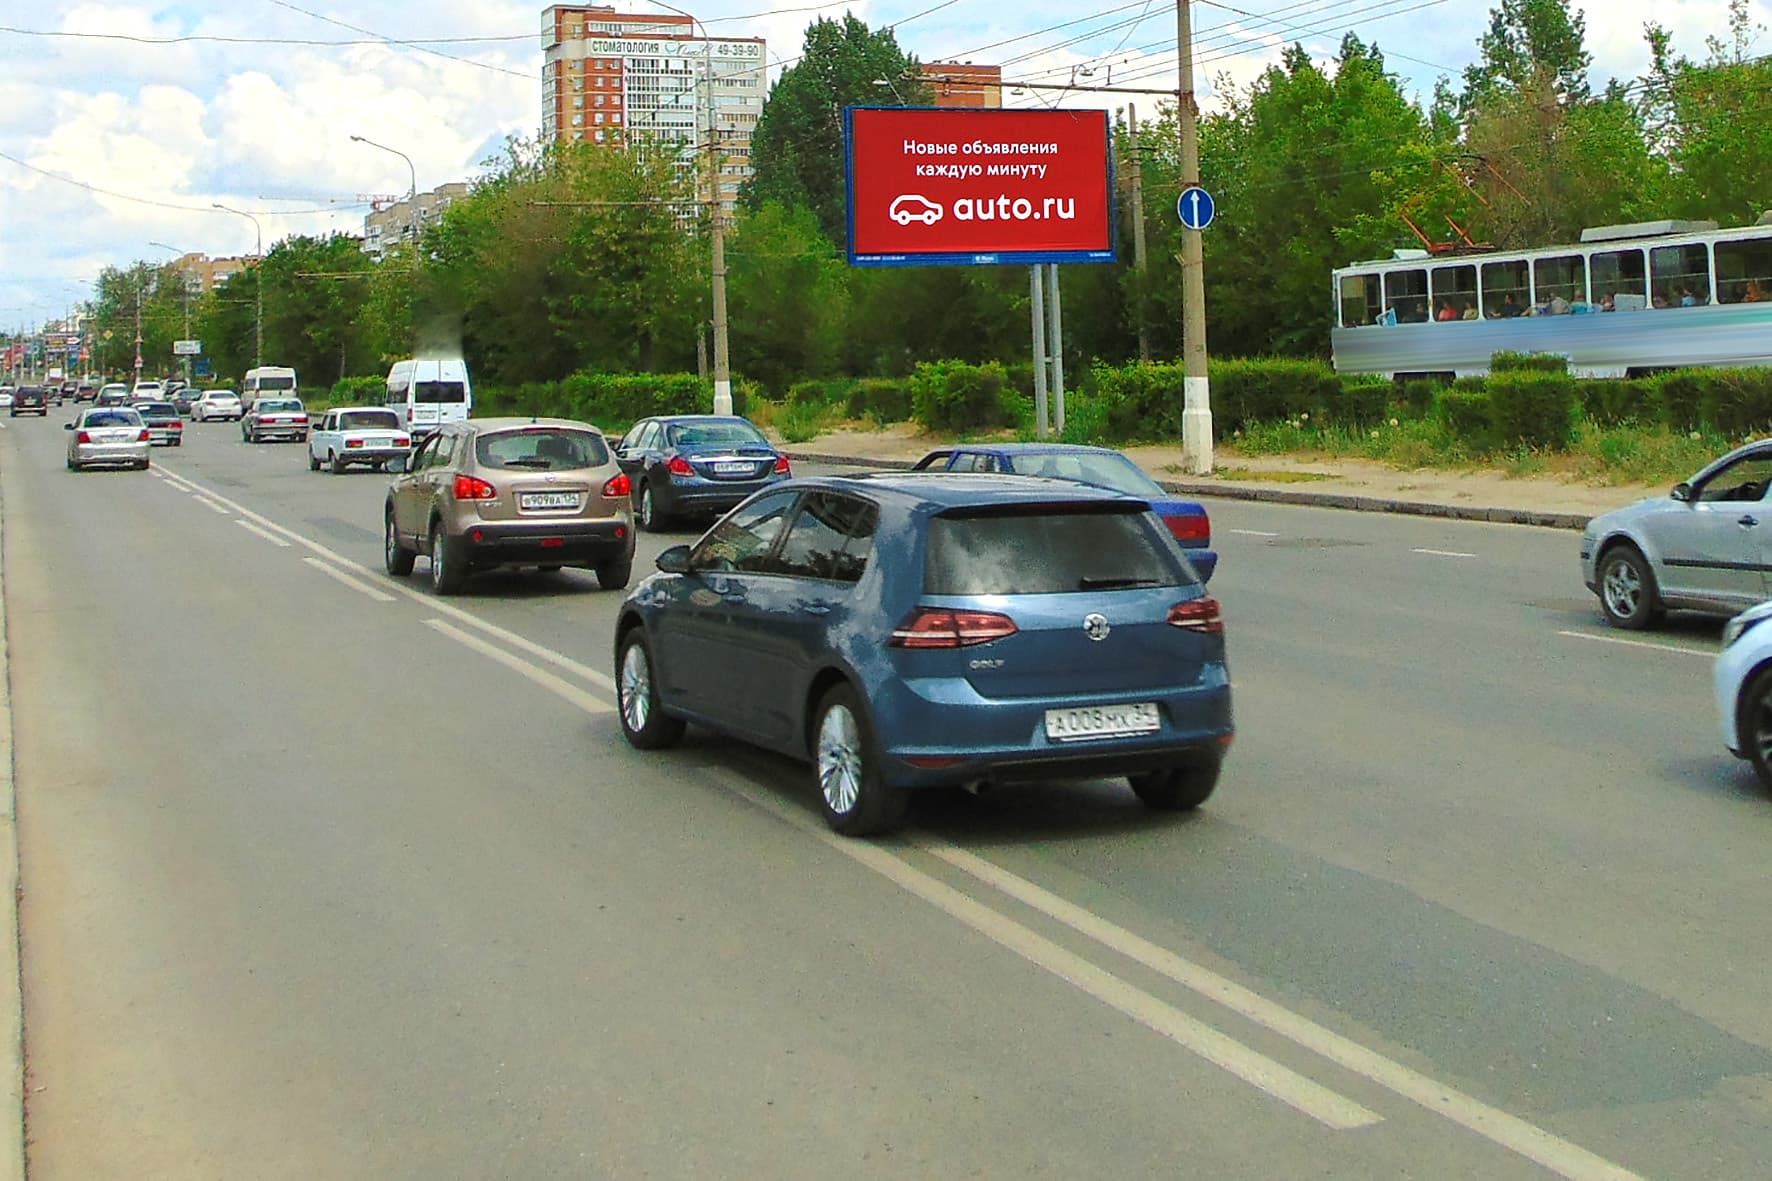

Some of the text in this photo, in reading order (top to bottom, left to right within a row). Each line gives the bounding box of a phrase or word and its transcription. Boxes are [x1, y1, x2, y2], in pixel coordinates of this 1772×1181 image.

[717, 45, 759, 57] 49-39-90
[903, 139, 1058, 155] Новые объявления
[916, 163, 1048, 179] каждую минуту
[953, 194, 1075, 220] auto.ru
